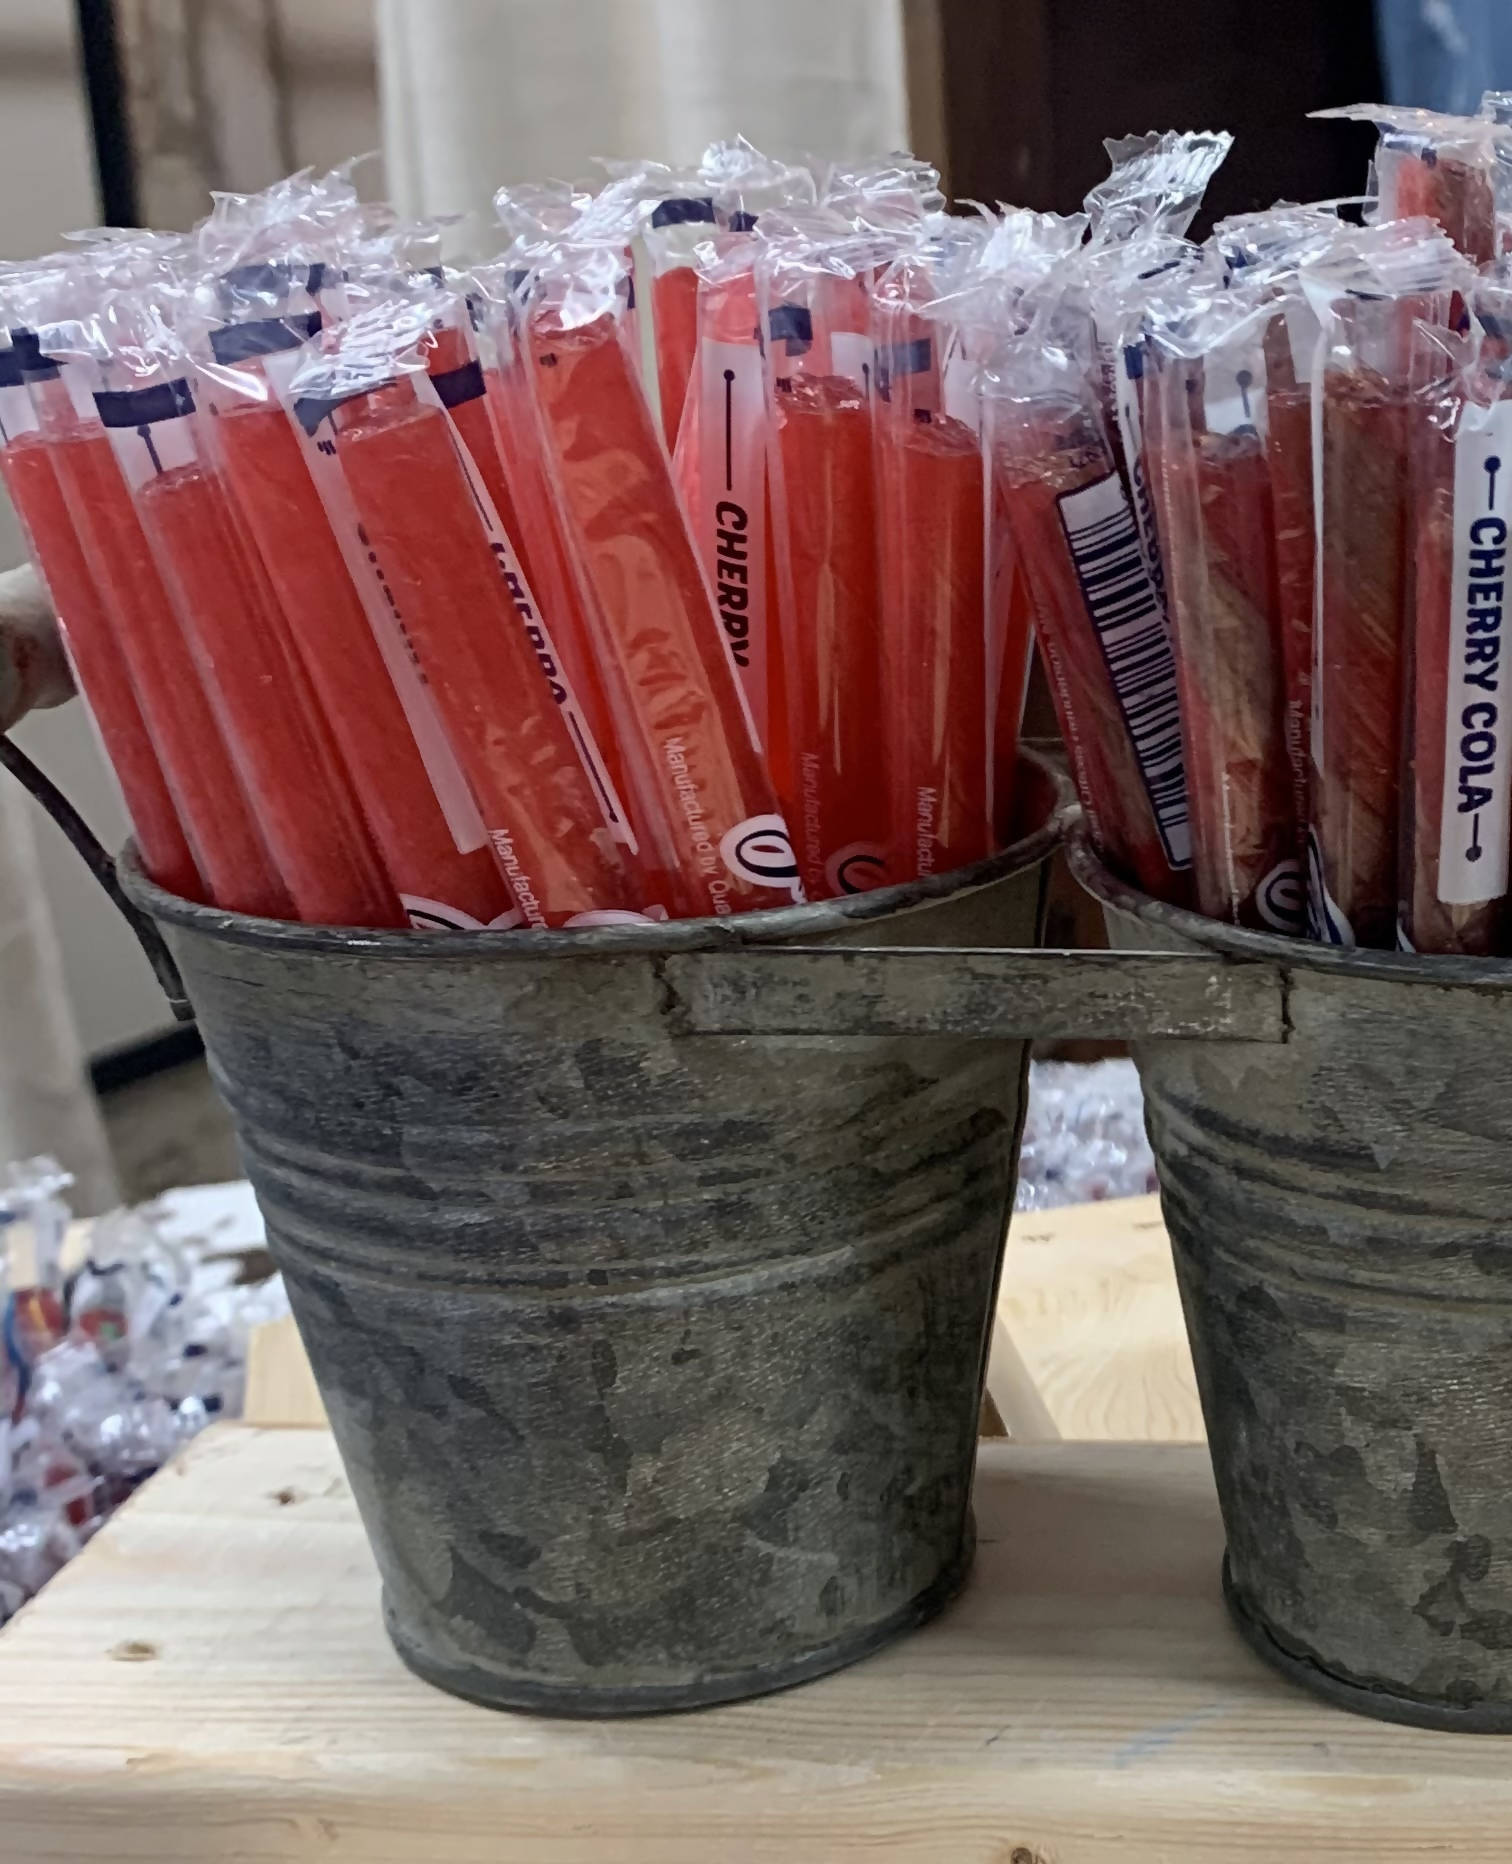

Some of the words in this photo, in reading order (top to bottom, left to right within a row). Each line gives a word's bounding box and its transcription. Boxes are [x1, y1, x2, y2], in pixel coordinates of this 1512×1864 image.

[1463, 516, 1508, 692] CHERRY
[664, 737, 709, 853] Manufactured
[700, 855, 719, 878] by
[1457, 701, 1498, 813] COLA
